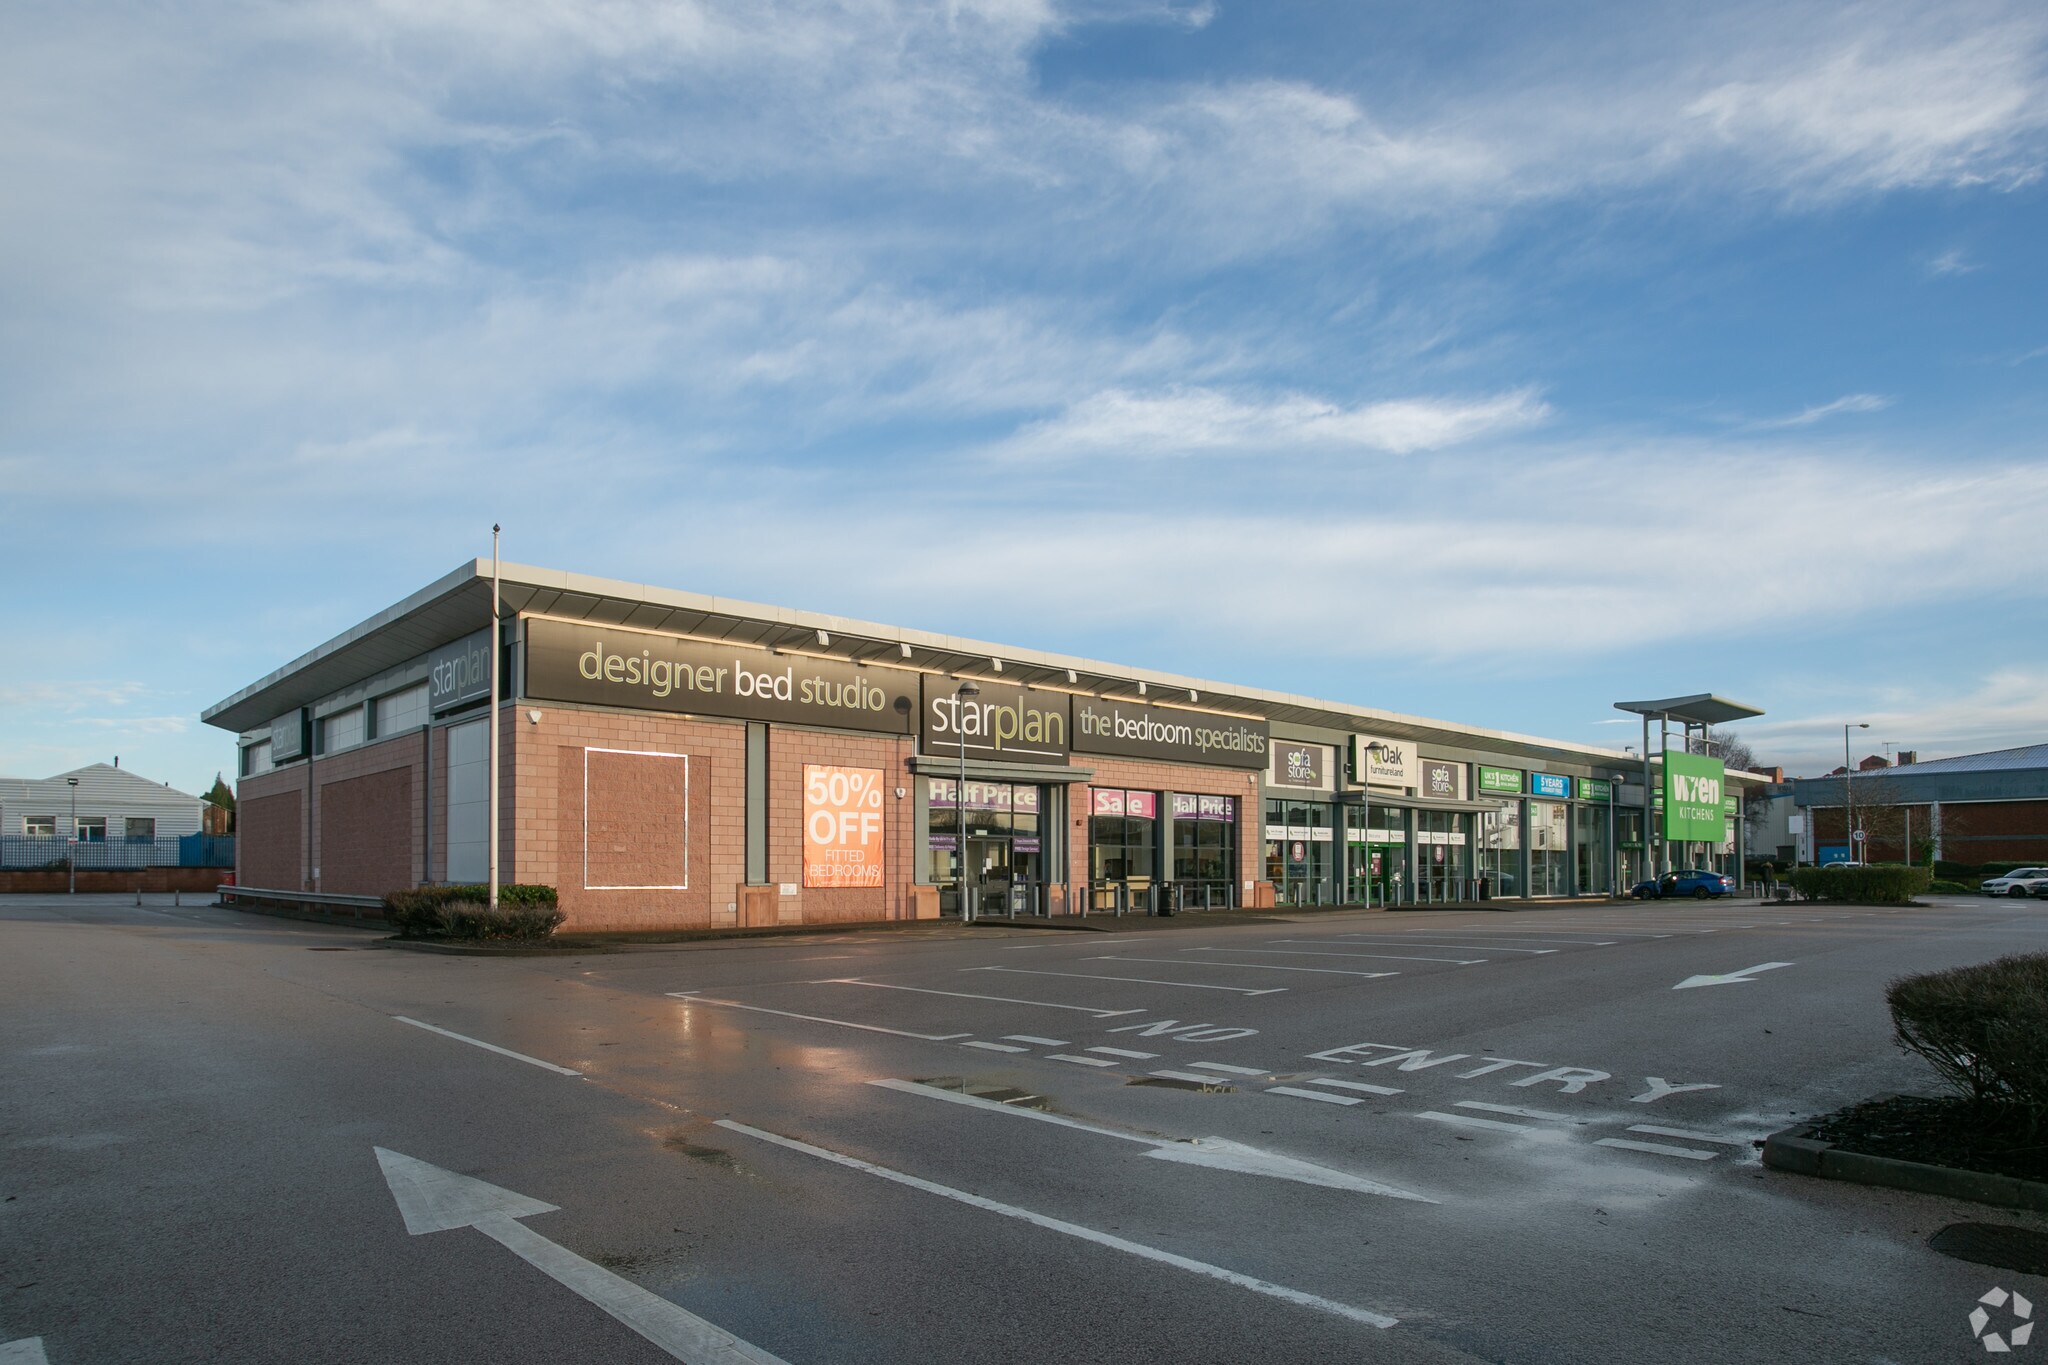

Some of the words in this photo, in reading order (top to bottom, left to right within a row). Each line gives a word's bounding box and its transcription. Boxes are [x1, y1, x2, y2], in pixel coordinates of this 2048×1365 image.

[433, 640, 490, 701] starplan
[579, 642, 727, 697] designer
[735, 660, 792, 701] bed
[800, 675, 886, 712] studio
[932, 693, 1064, 751] starplan
[1080, 706, 1111, 737] the
[1115, 710, 1192, 745] bedroom
[1195, 727, 1265, 754] specialists
[1288, 748, 1311, 767] sofa
[1382, 745, 1403, 765] Oak
[1288, 765, 1311, 780] store
[1370, 765, 1403, 777] furnitureland
[1431, 765, 1449, 782] sofa
[807, 771, 881, 808] 50%
[1431, 781, 1450, 793] store
[1541, 777, 1545, 787] 5
[1545, 778, 1563, 789] YEARS
[1673, 774, 1719, 805] wren
[929, 782, 980, 803] Half
[983, 785, 1037, 806] Price
[1173, 796, 1197, 814] Half
[1201, 798, 1232, 816] Price
[1679, 808, 1714, 821] KITCHENS
[808, 810, 880, 845] OFF
[1855, 831, 1864, 839] 10
[825, 849, 865, 862] FITTED
[810, 864, 880, 877] BEDROOMS
[1106, 1019, 1260, 1042] NO
[1304, 1042, 1722, 1103] ENTRY
